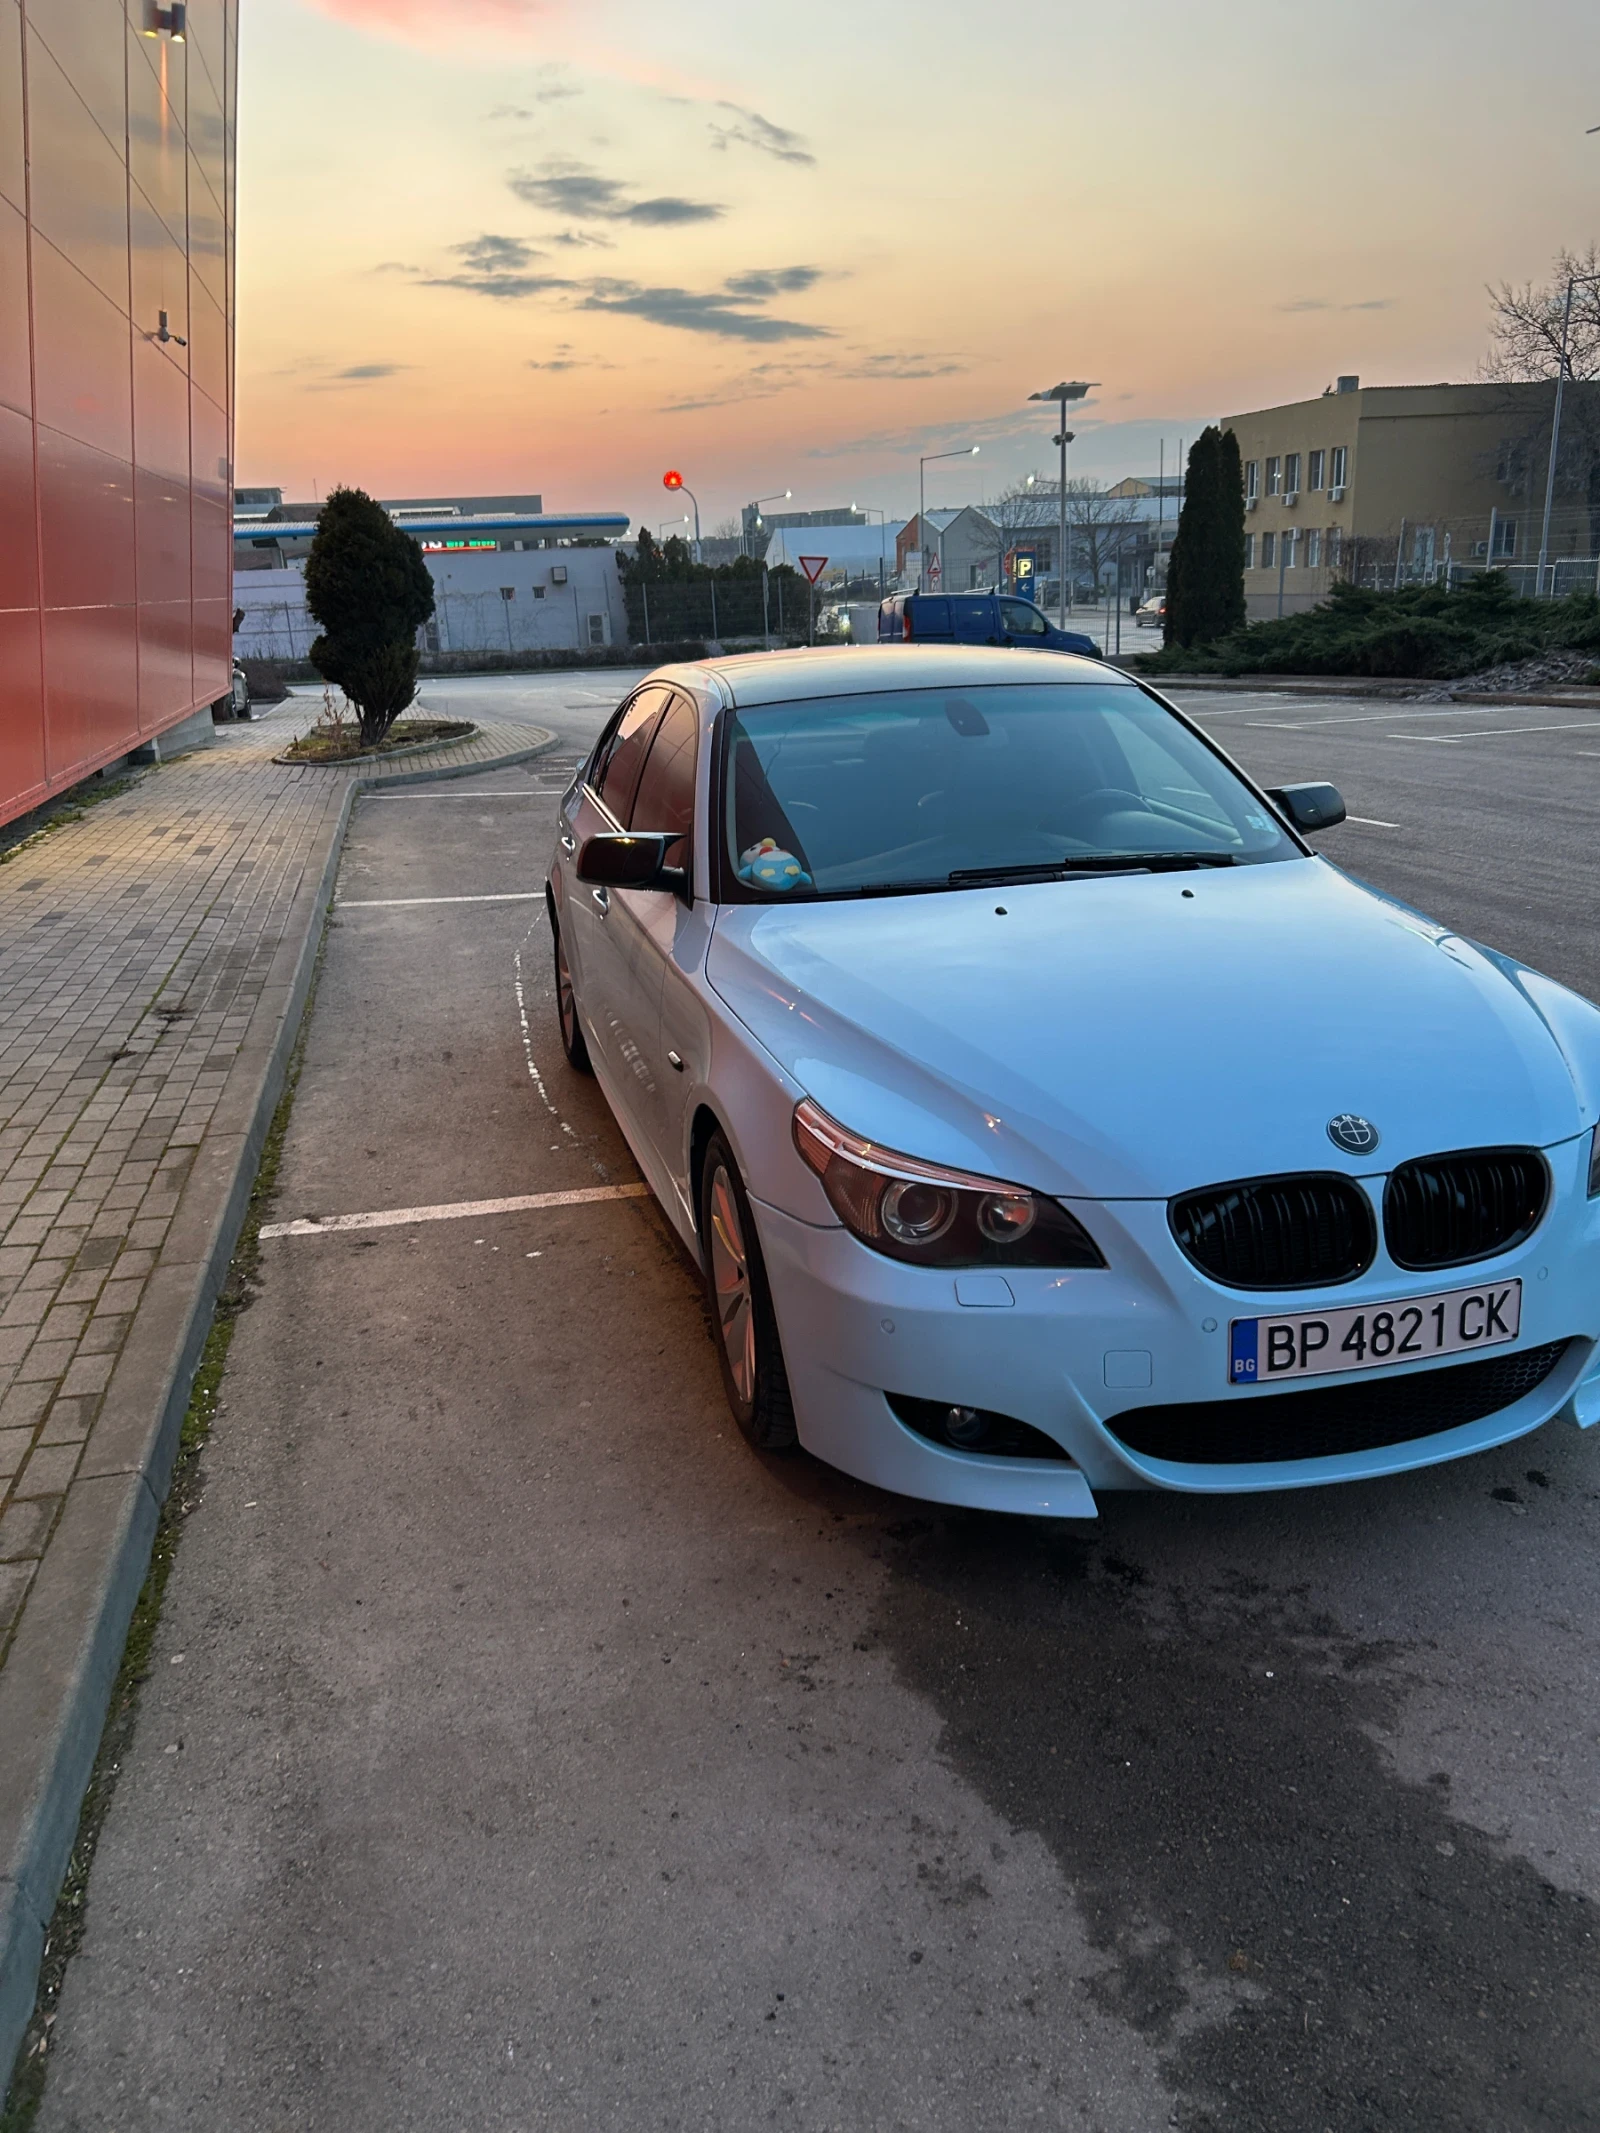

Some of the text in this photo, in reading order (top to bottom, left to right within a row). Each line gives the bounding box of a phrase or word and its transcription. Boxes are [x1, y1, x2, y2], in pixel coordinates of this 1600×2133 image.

[1020, 561, 1031, 576] P
[1331, 1114, 1369, 1127] BMW
[1267, 1289, 1512, 1372] BP 4821 CK
[1234, 1358, 1255, 1373] BG
